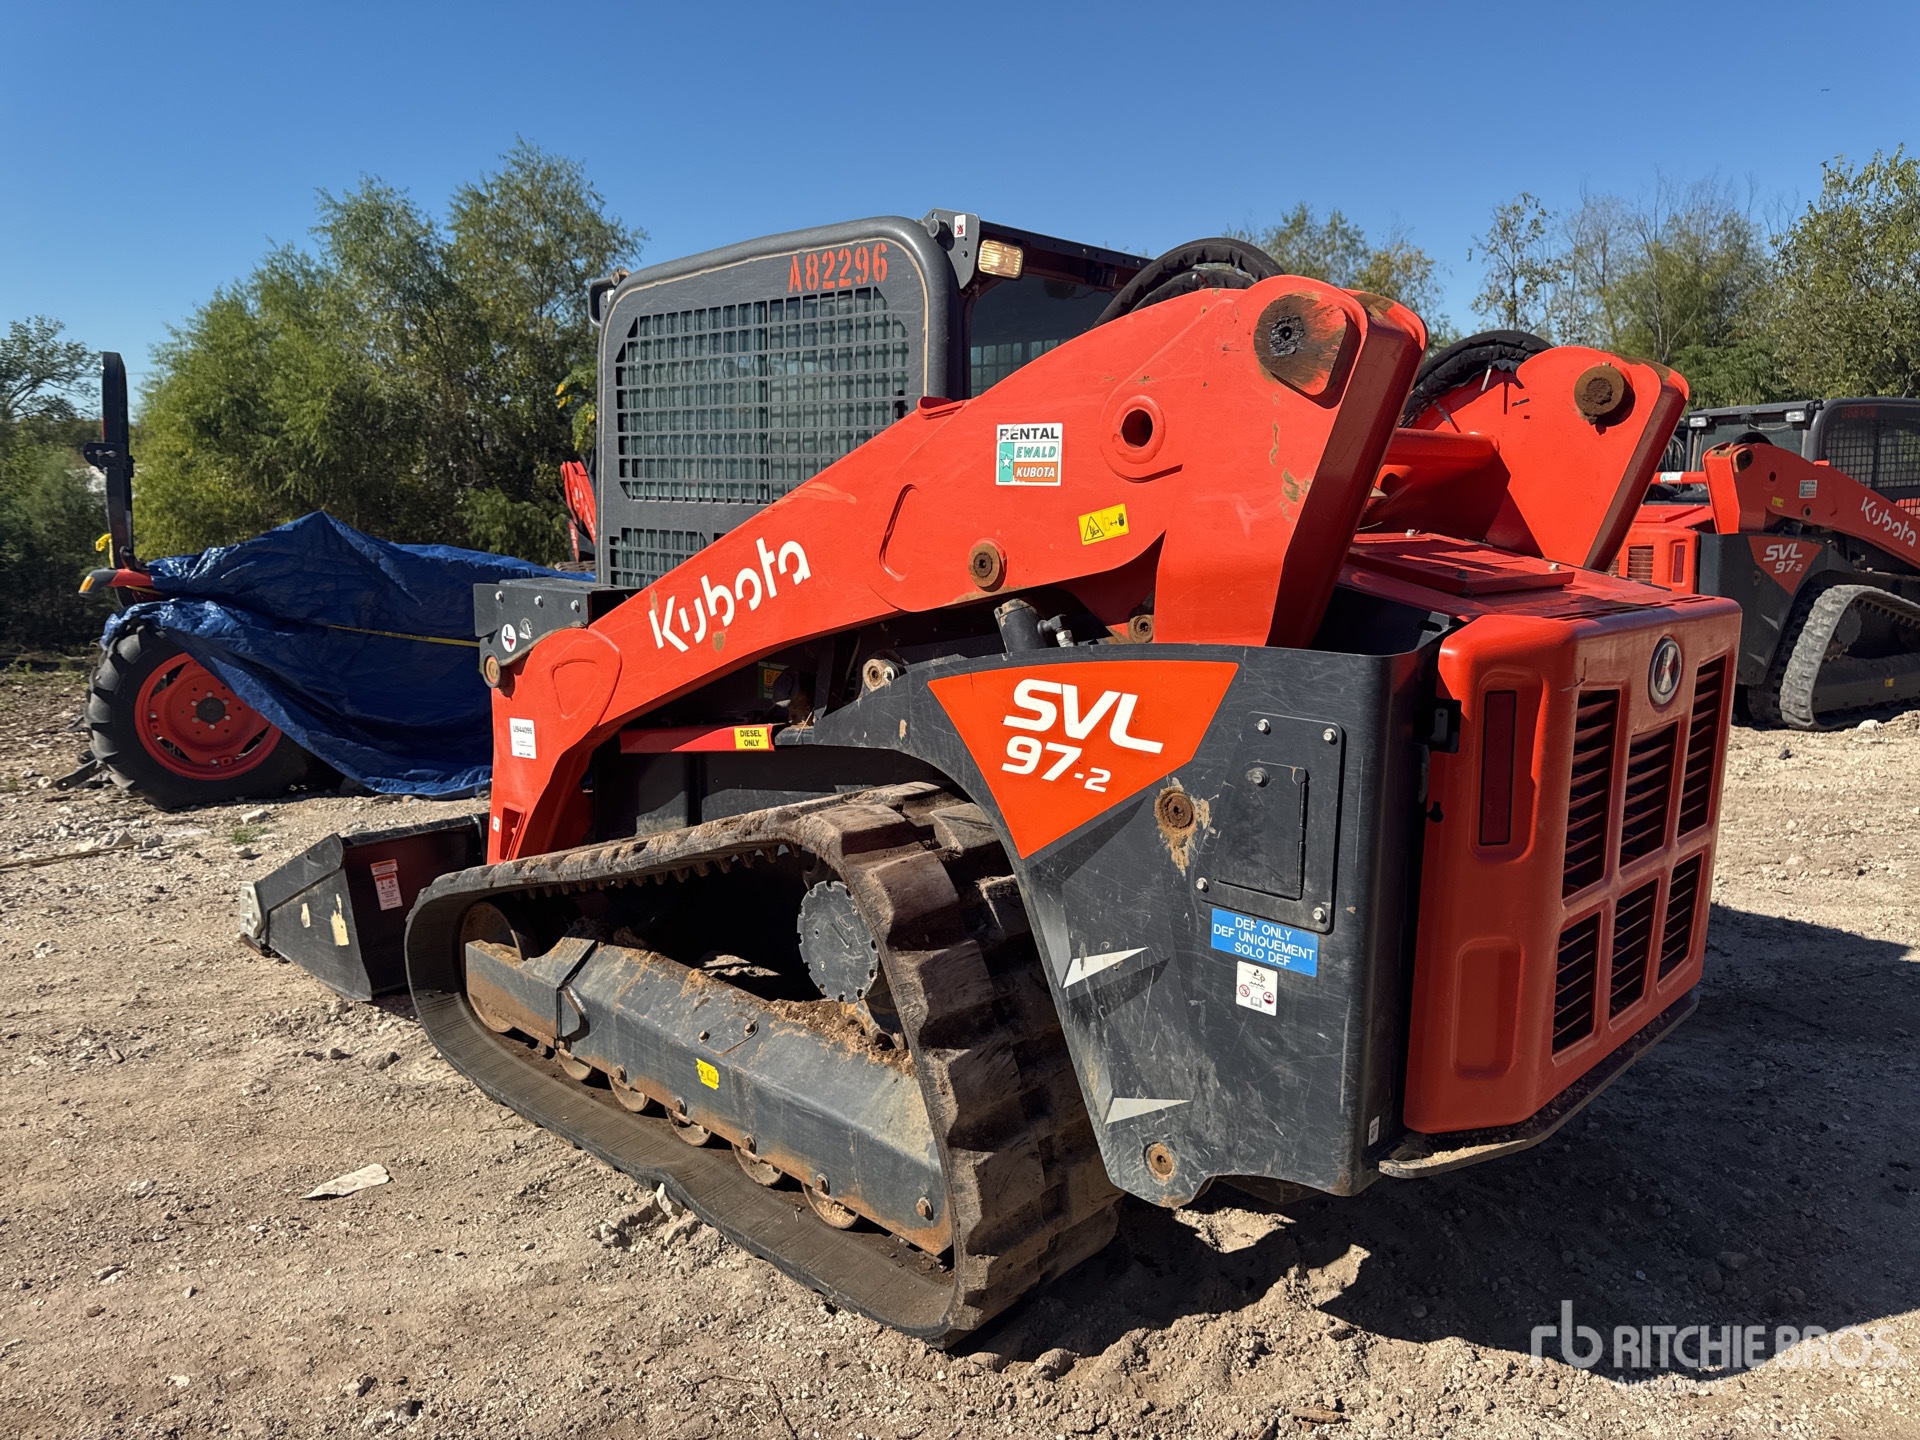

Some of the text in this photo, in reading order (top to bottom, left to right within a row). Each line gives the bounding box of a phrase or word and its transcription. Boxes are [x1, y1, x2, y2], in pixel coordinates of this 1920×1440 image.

[788, 242, 888, 293] A82296
[1000, 427, 1059, 440] RENTAL
[1016, 446, 1057, 458] EWALD
[1016, 466, 1055, 478] KUBOTA
[1860, 496, 1917, 548] Kubota
[1763, 543, 1803, 562] SVL
[1774, 560, 1803, 574] 97-2
[648, 536, 812, 653] Kubota
[1002, 678, 1164, 754] SVL
[739, 729, 762, 738] DIESEL
[743, 739, 760, 747] ONLY
[1001, 735, 1112, 793] 97-2
[1235, 917, 1292, 941] DEF ONLY
[1213, 923, 1315, 960] DEF UNIQUEMENT
[1234, 942, 1291, 966] SOLO DEF
